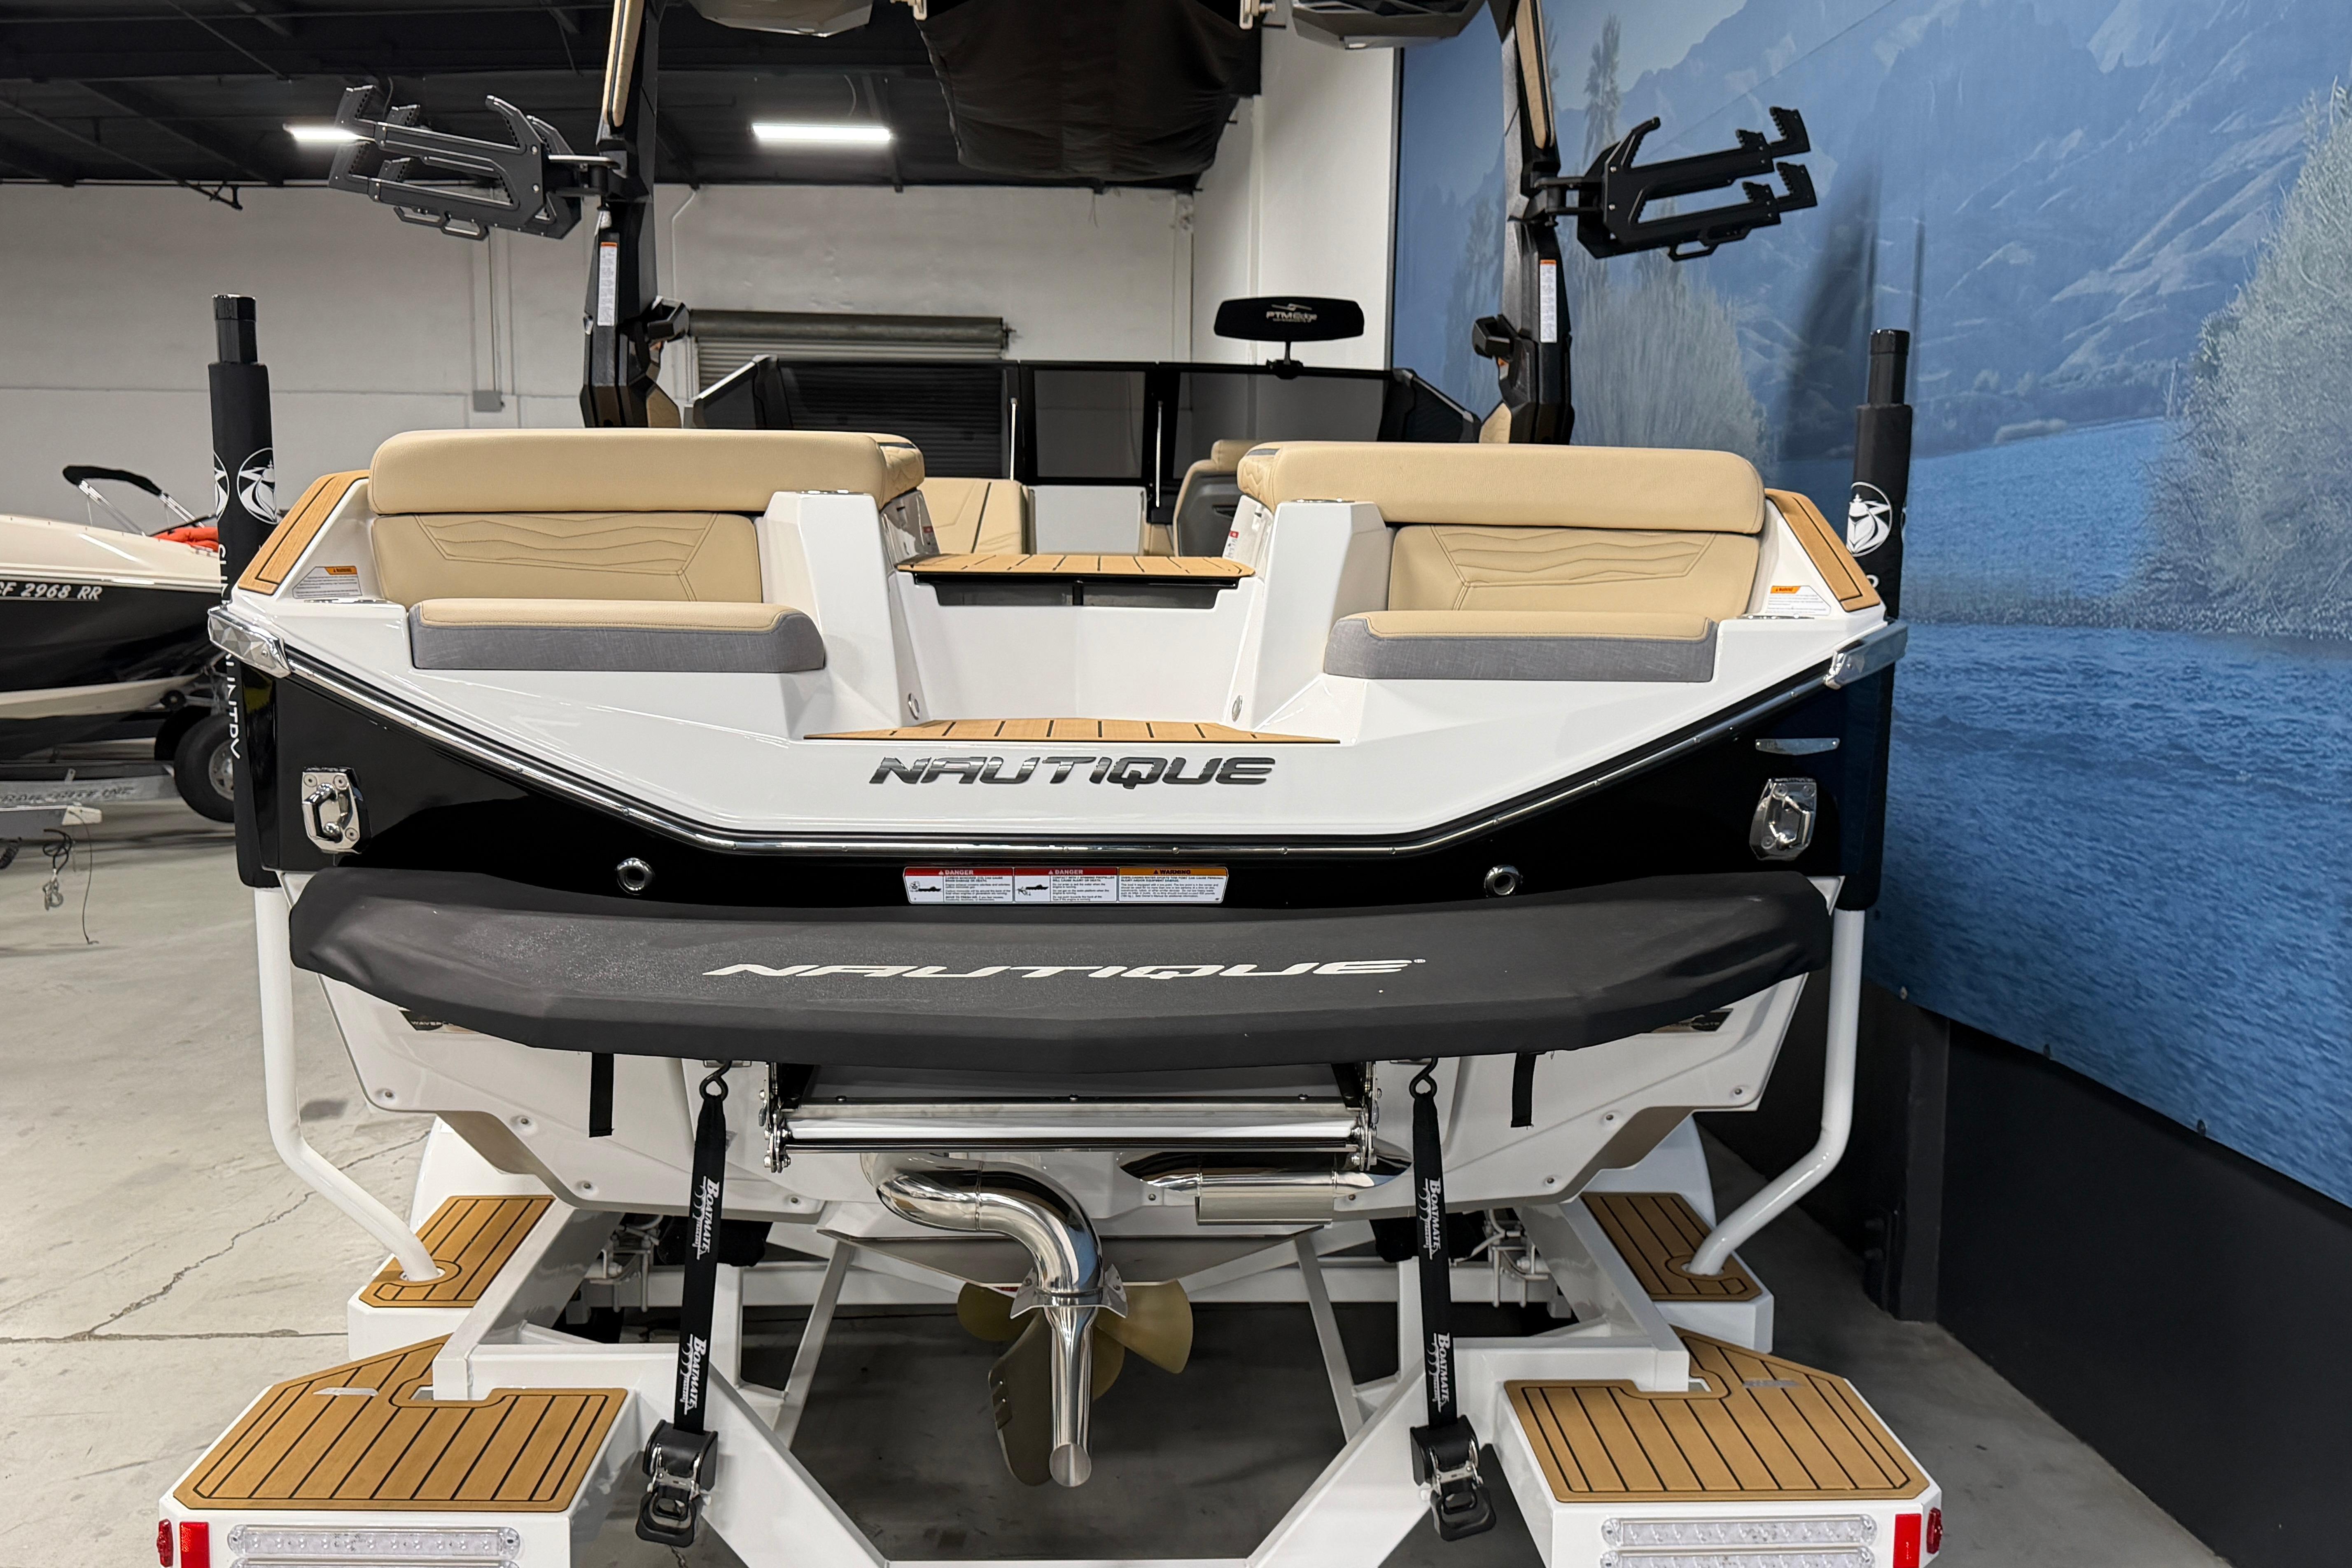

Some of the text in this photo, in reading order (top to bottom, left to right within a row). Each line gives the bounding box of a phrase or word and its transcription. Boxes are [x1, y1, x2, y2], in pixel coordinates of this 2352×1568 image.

[21, 583, 71, 599] 2968
[77, 586, 102, 600] RR
[869, 756, 1276, 789] NAUTIQUE
[702, 960, 1412, 979] NAUTIQUE
[702, 1178, 720, 1253] BOATMATE
[1429, 1177, 1441, 1250] BOATMATE
[689, 1336, 707, 1408] BOATMATE
[1437, 1332, 1451, 1403] BOATMATE
